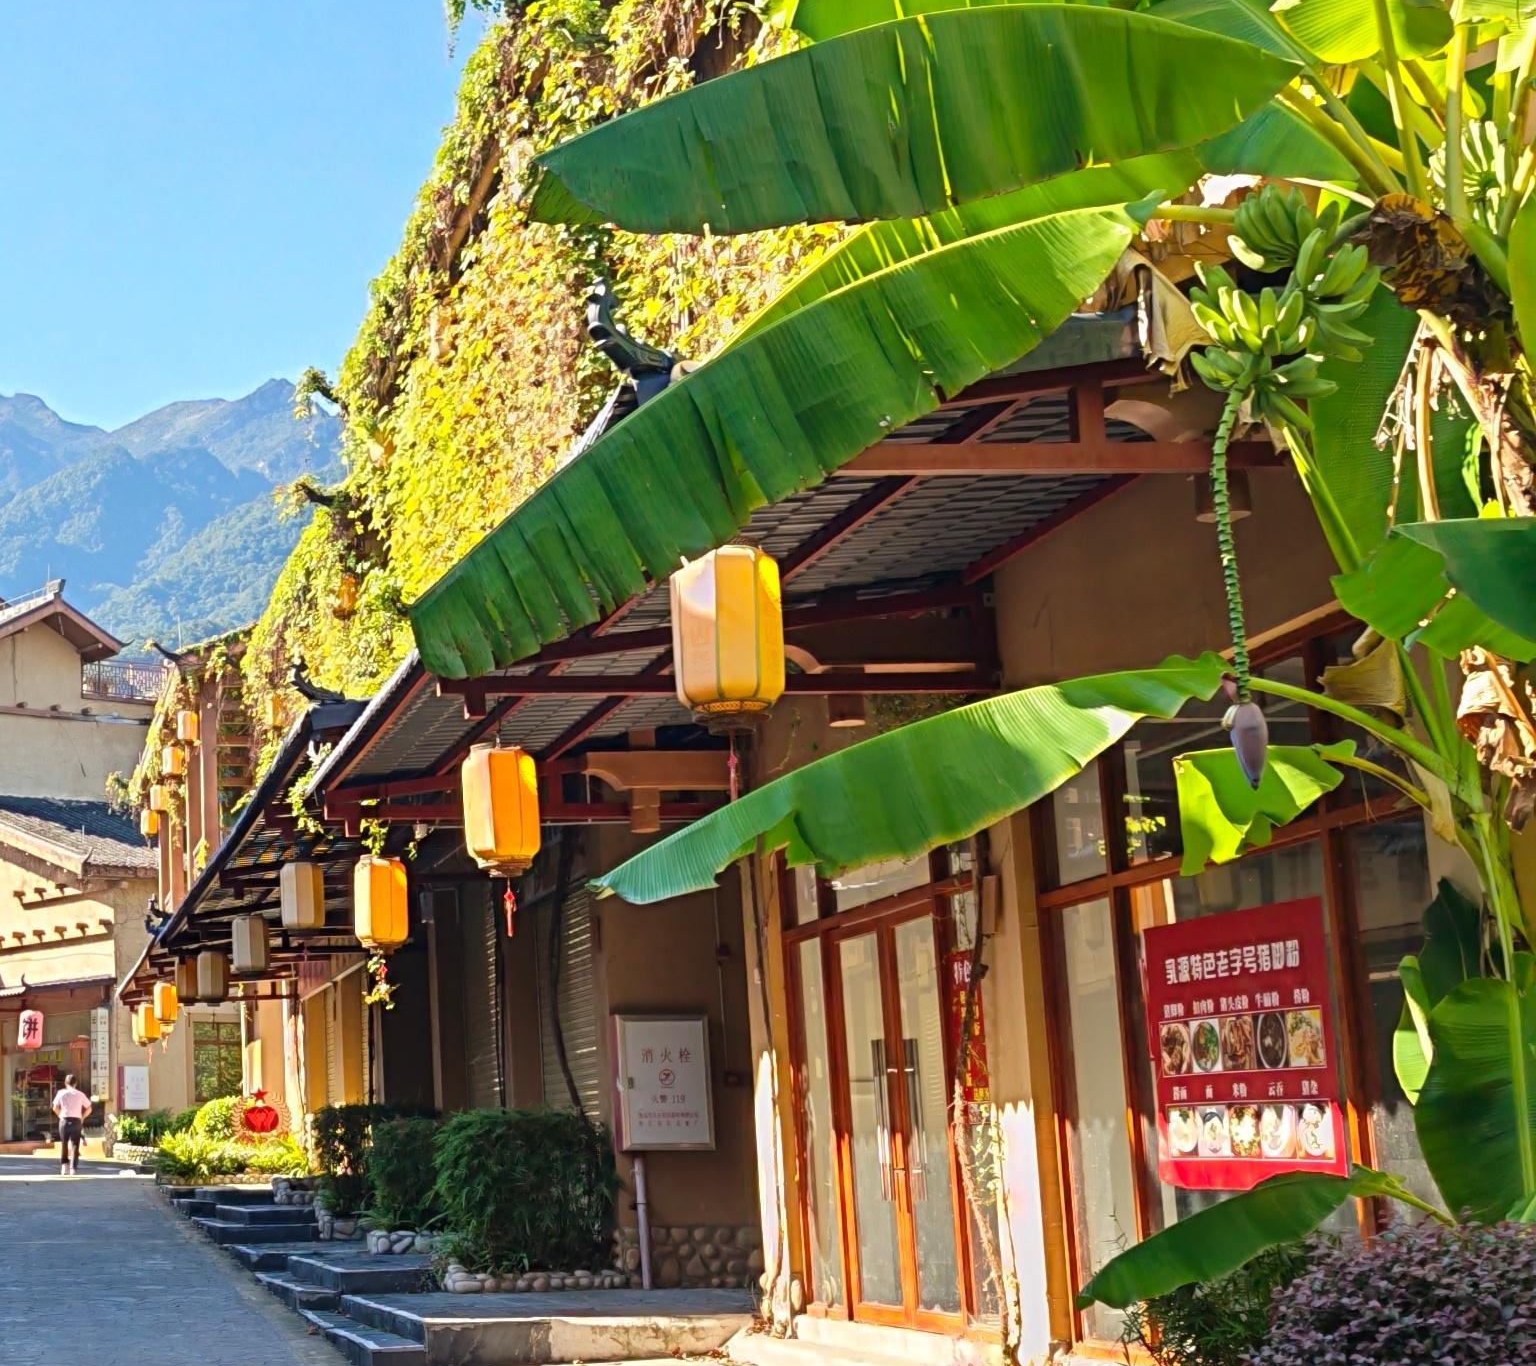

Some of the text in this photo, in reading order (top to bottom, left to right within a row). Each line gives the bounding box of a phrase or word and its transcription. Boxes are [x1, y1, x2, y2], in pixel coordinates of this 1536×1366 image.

[1165, 939, 1300, 985] 乳源特色老字号猪脚粉
[641, 1047, 692, 1064] 消火栓
